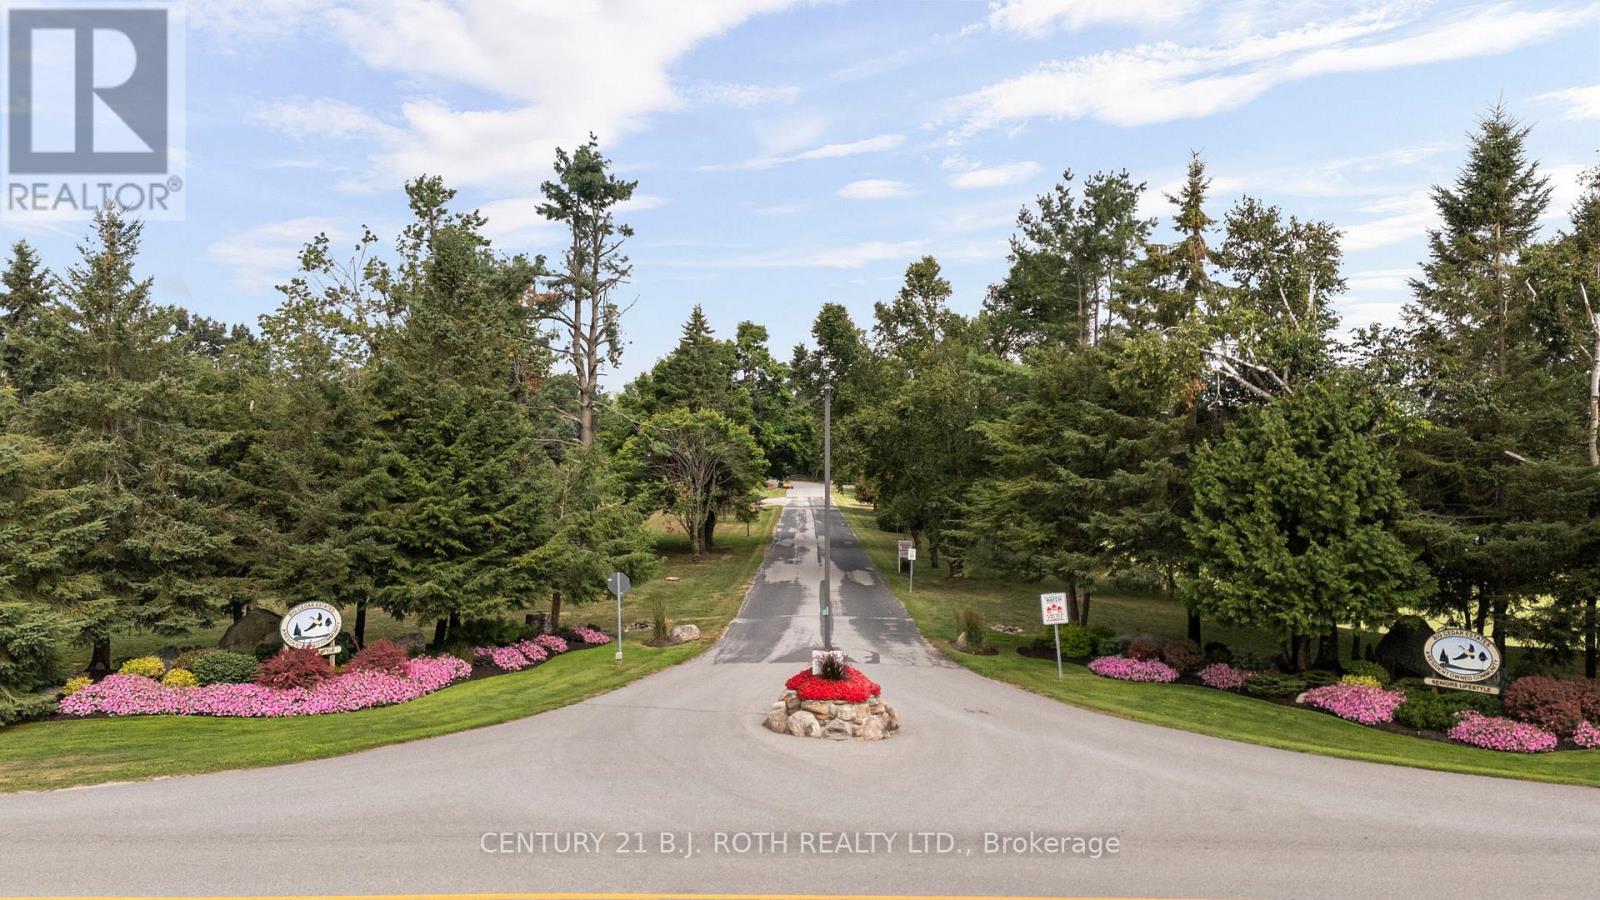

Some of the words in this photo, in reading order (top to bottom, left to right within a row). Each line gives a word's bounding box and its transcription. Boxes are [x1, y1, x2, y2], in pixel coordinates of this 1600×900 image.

[1465, 631, 1490, 647] ESTATES
[1450, 673, 1473, 681] OWNED
[1431, 679, 1458, 688] SENIORS
[1459, 682, 1492, 693] LIFESTYLE
